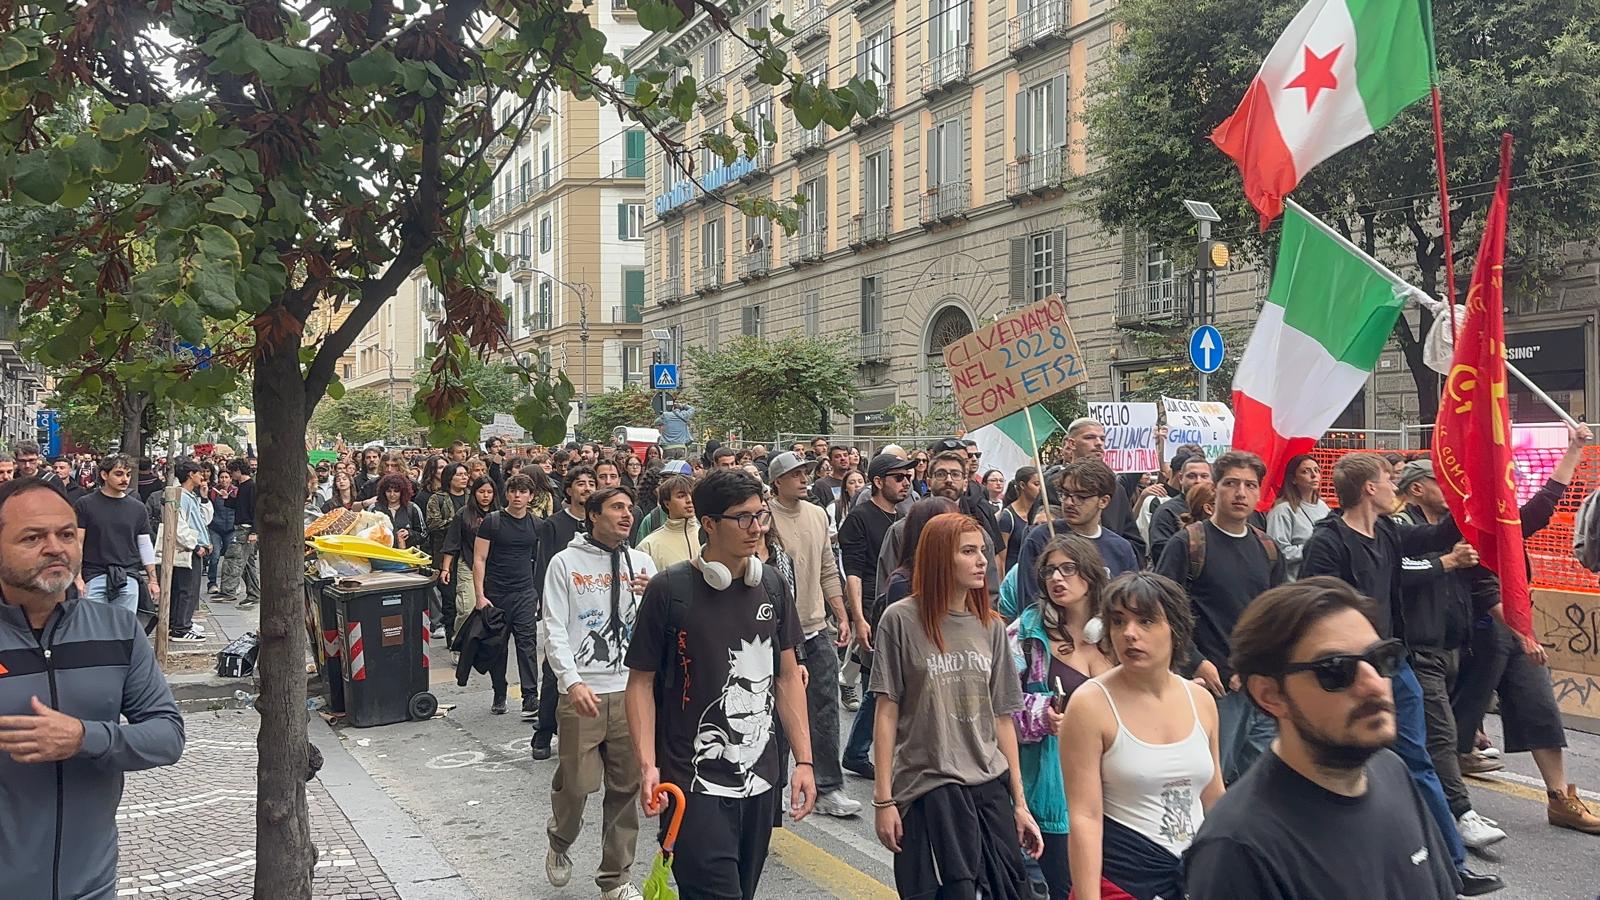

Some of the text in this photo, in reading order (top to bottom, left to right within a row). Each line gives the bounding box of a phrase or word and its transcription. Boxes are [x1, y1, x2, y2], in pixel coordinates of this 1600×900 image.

[948, 299, 1065, 368] CI VEDIAMO
[953, 325, 1067, 394] NEL 2028
[961, 376, 1016, 417] CON
[1089, 404, 1130, 426] MEGLIO
[1198, 415, 1211, 428] IN
[1104, 426, 1152, 449] GLI UNICI
[1169, 429, 1218, 444] GIACCA E
[926, 653, 965, 680] HARD
